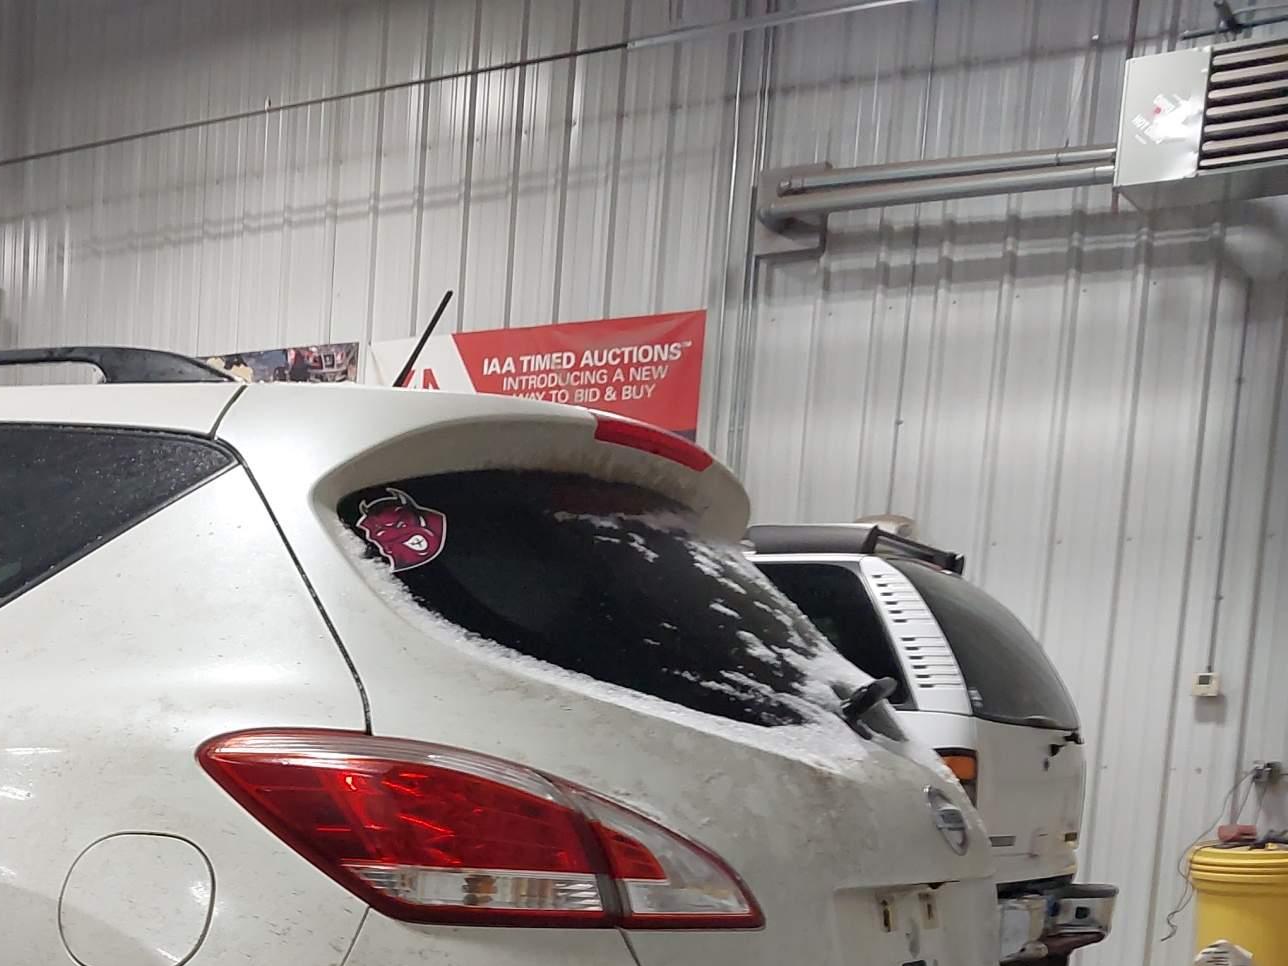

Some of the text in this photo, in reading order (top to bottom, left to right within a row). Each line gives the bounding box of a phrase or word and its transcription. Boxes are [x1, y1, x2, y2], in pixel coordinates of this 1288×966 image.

[483, 356, 515, 376] IAA
[520, 351, 575, 373] TIMED
[503, 365, 669, 392] INTRODUCING A NEW
[549, 389, 569, 404] TO
[574, 387, 600, 403] BID
[604, 386, 617, 402] &
[622, 383, 656, 400] BUY
